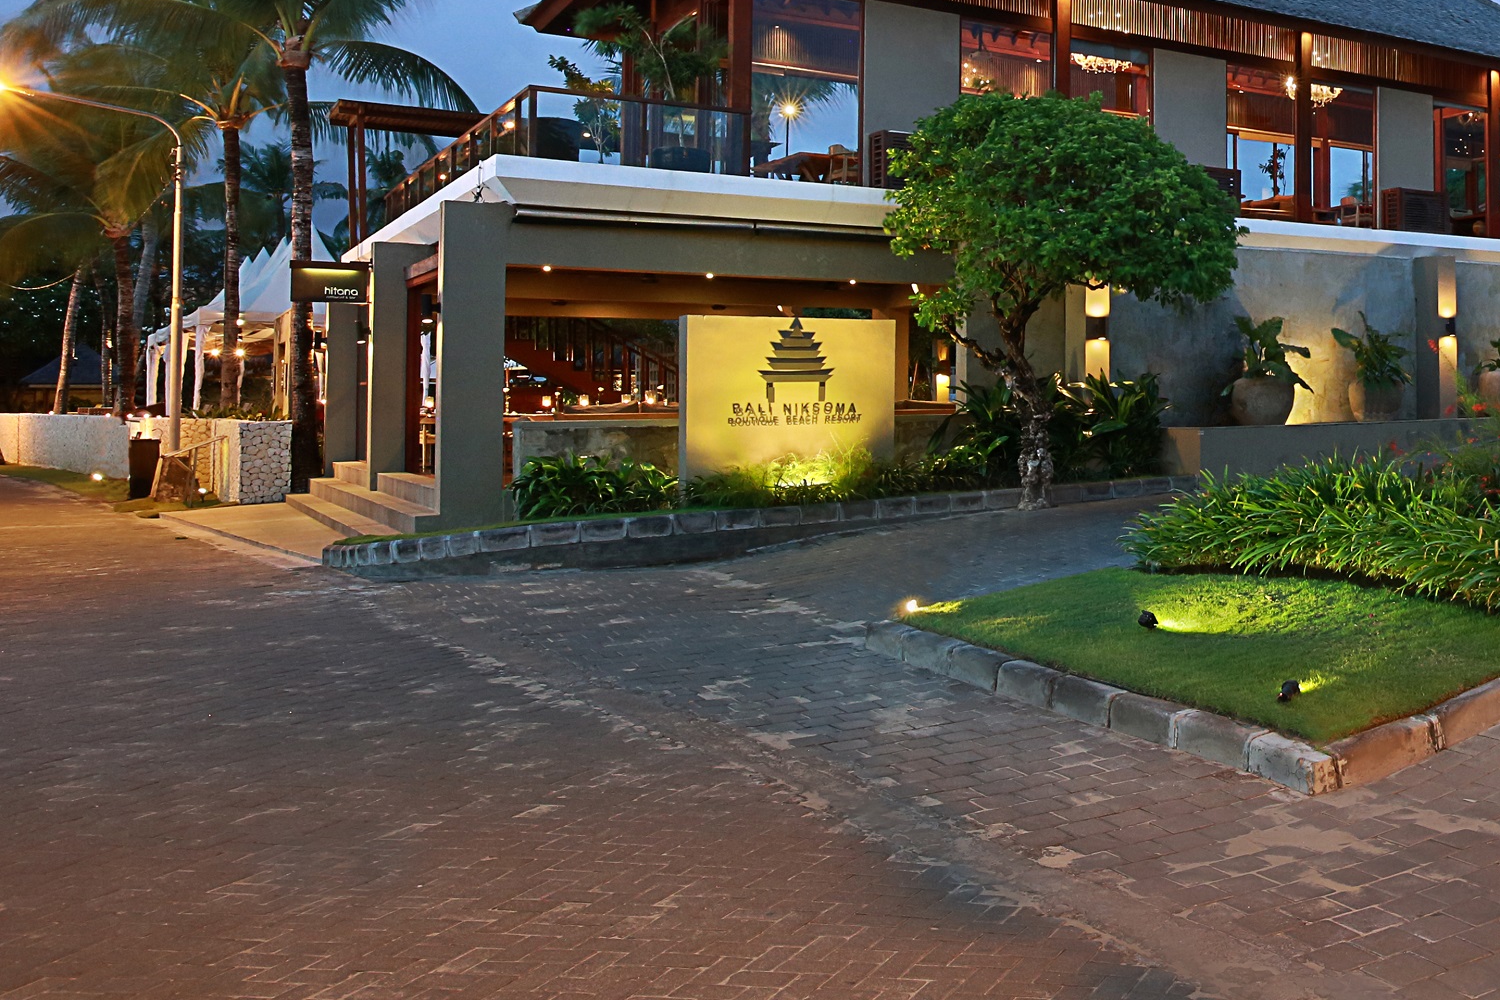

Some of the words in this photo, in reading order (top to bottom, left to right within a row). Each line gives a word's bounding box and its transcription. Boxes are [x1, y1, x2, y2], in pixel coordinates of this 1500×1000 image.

[732, 402, 773, 416] BALI
[783, 402, 857, 416] NIKSOMA
[727, 416, 779, 427] BOUTIQUE
[786, 415, 818, 425] BEACH
[824, 413, 862, 425] RESORT
